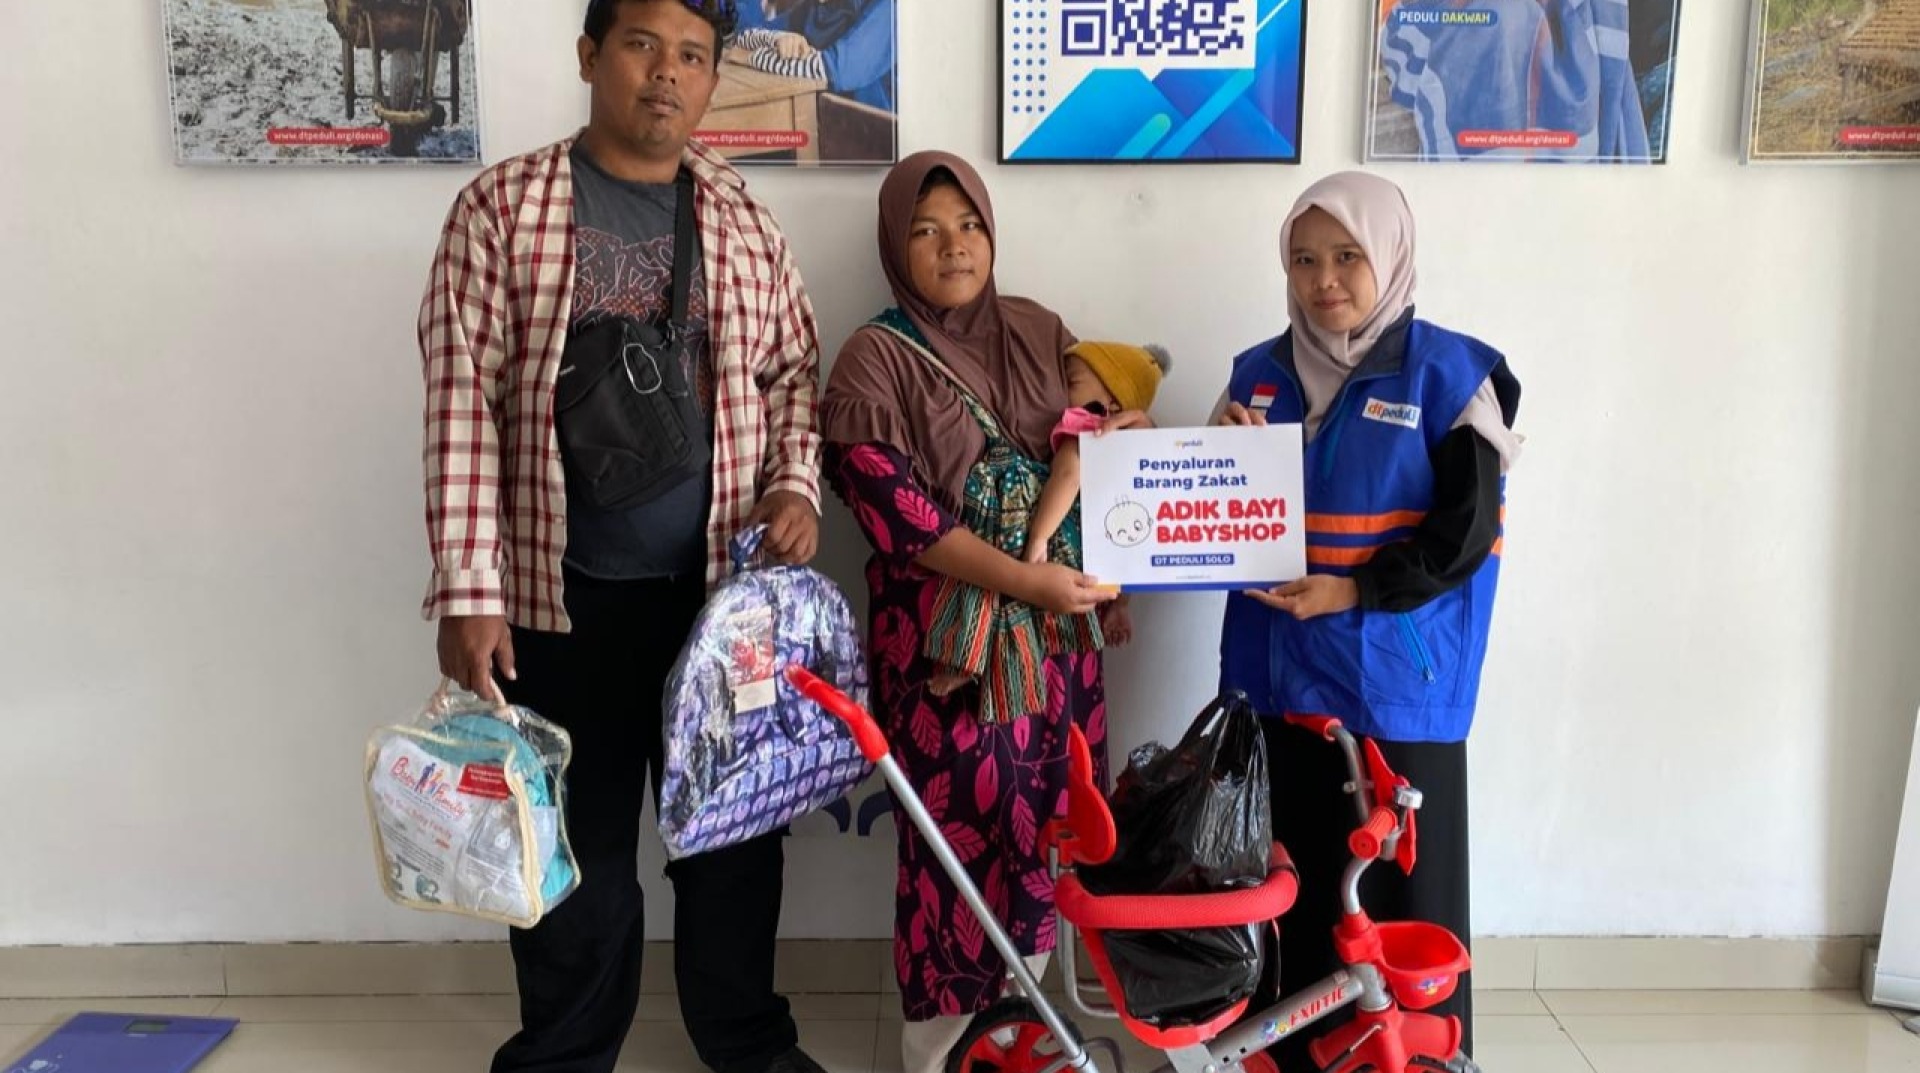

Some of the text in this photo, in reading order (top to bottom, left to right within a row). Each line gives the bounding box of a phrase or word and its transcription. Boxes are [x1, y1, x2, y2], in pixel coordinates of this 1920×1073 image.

[1400, 11, 1490, 24] PEDULI DAKWAH
[273, 131, 383, 141] www.dtpeduli.org/donasi
[1464, 134, 1570, 144] www.dtpeduli.org/donasi
[1139, 456, 1236, 473] Penyaluran
[1133, 474, 1248, 490] Barang Zakat
[1156, 498, 1286, 521] ADIK BAYI
[1156, 523, 1287, 544] BABYSHOP
[1154, 554, 1231, 566] DT PEDULI SOLO
[1288, 985, 1346, 1028] EXOTIC
